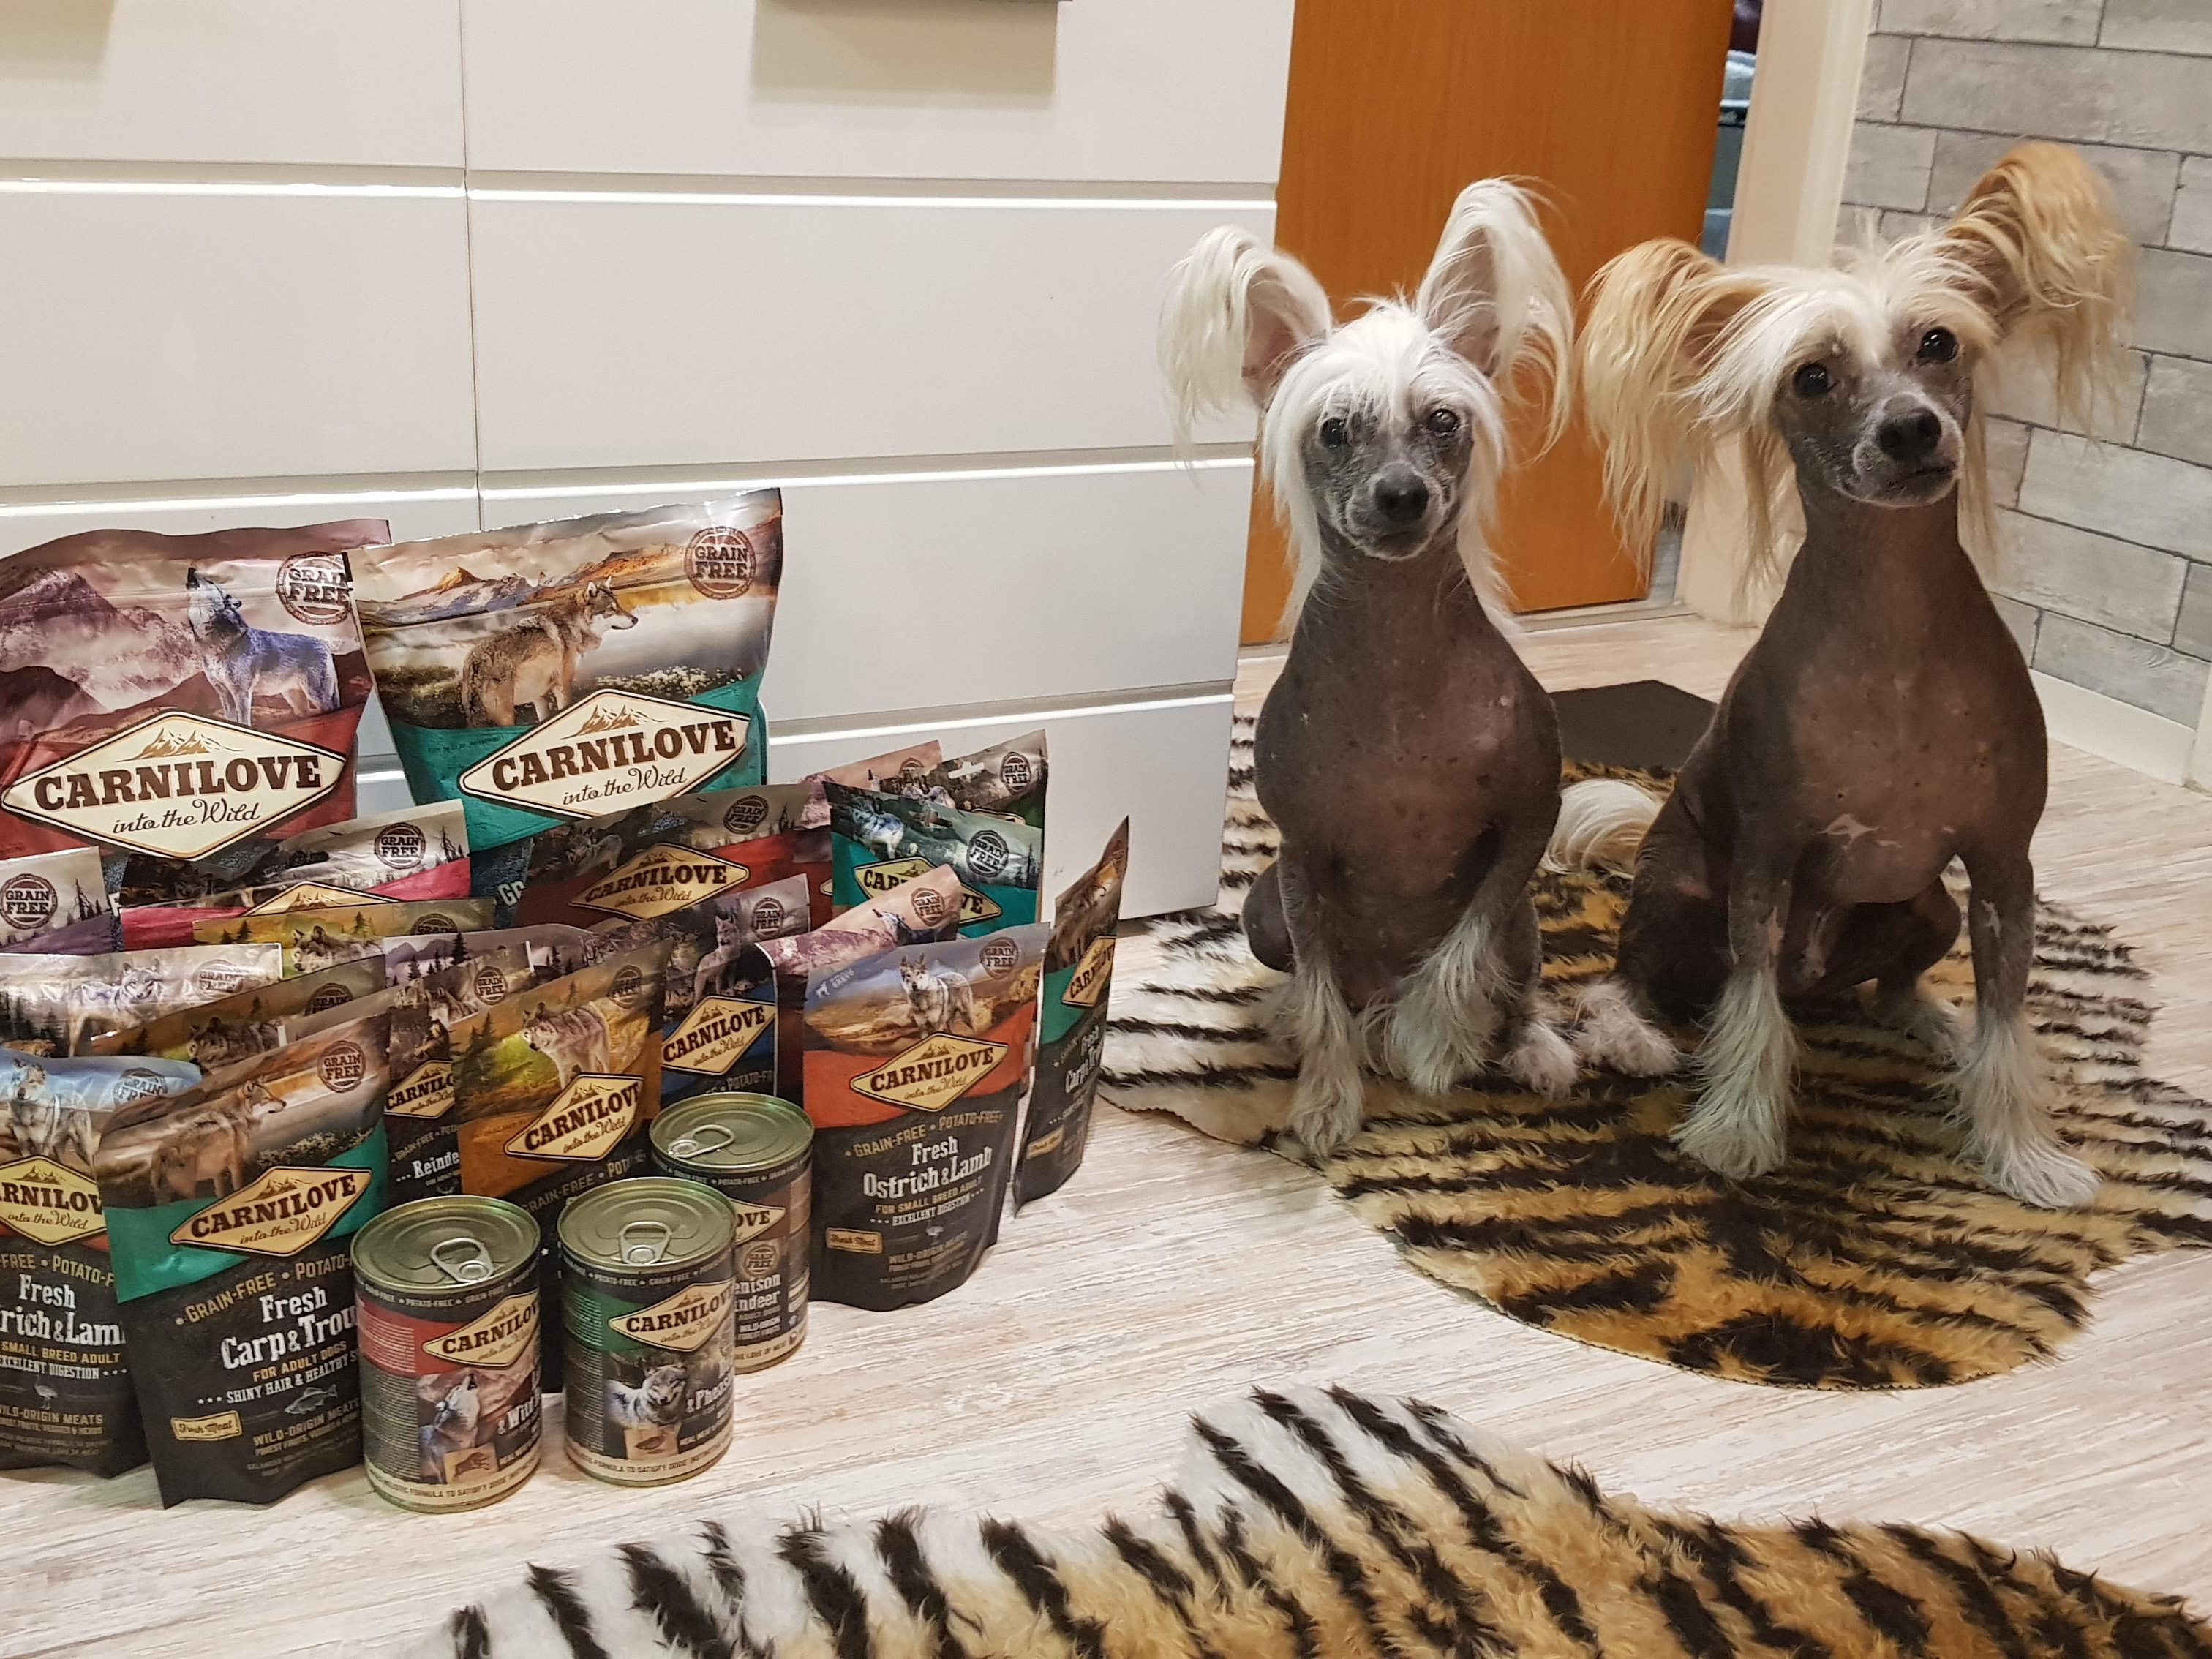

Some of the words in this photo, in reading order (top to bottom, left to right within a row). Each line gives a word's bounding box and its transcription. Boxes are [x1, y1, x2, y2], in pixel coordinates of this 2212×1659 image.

[694, 542, 748, 563] GRAIN
[695, 560, 749, 582] FREE
[492, 721, 737, 792] CARNILOVE
[34, 755, 323, 812] CARNILOVE
[563, 783, 603, 805] into
[604, 778, 635, 797] the
[628, 765, 688, 791] Wild
[113, 817, 159, 835] into
[160, 807, 195, 830] the
[192, 798, 263, 824] Wild
[380, 845, 420, 858] FREE
[381, 835, 421, 848] GRAIN
[973, 838, 1006, 859] GRAIN
[970, 848, 1002, 868] FREE
[6, 889, 50, 902] GRAIN
[585, 865, 727, 903] CARNILOVE
[6, 901, 50, 916] FREE
[915, 892, 945, 909] GRAIN
[917, 903, 945, 918] FREE
[663, 1005, 766, 1063] CARNILOVE
[323, 1053, 362, 1068] GRAIN
[325, 1064, 361, 1080] FREE
[870, 1047, 994, 1093] CARNILOVE
[524, 1081, 639, 1151] CARNILOV
[853, 1124, 928, 1158] GRAIN-FREE
[912, 1135, 958, 1166] Fresh
[412, 1151, 461, 1179] Reinde
[192, 1174, 356, 1239] CARNILOVE
[898, 1198, 930, 1212] SMALL
[50, 1209, 89, 1230] Wild
[19, 1273, 77, 1310] Fresh
[185, 1271, 277, 1324] GRAIN-FREE
[259, 1285, 328, 1323] Fresh
[626, 1290, 733, 1333] CARNILOV
[1, 1340, 38, 1357] SMALL
[42, 1347, 78, 1363] BREED
[81, 1352, 121, 1365] ADULT
[252, 1369, 277, 1382] FOR
[281, 1355, 319, 1374] ADULT
[320, 1340, 347, 1362] DOGS
[49, 1364, 100, 1380] DIGESTION
[226, 1386, 263, 1404] SHINY
[266, 1375, 294, 1396] HAIR
[305, 1357, 349, 1383] HEALTHY
[63, 1412, 103, 1425] MEATS
[253, 1418, 325, 1447] WILD-ORIGIN
